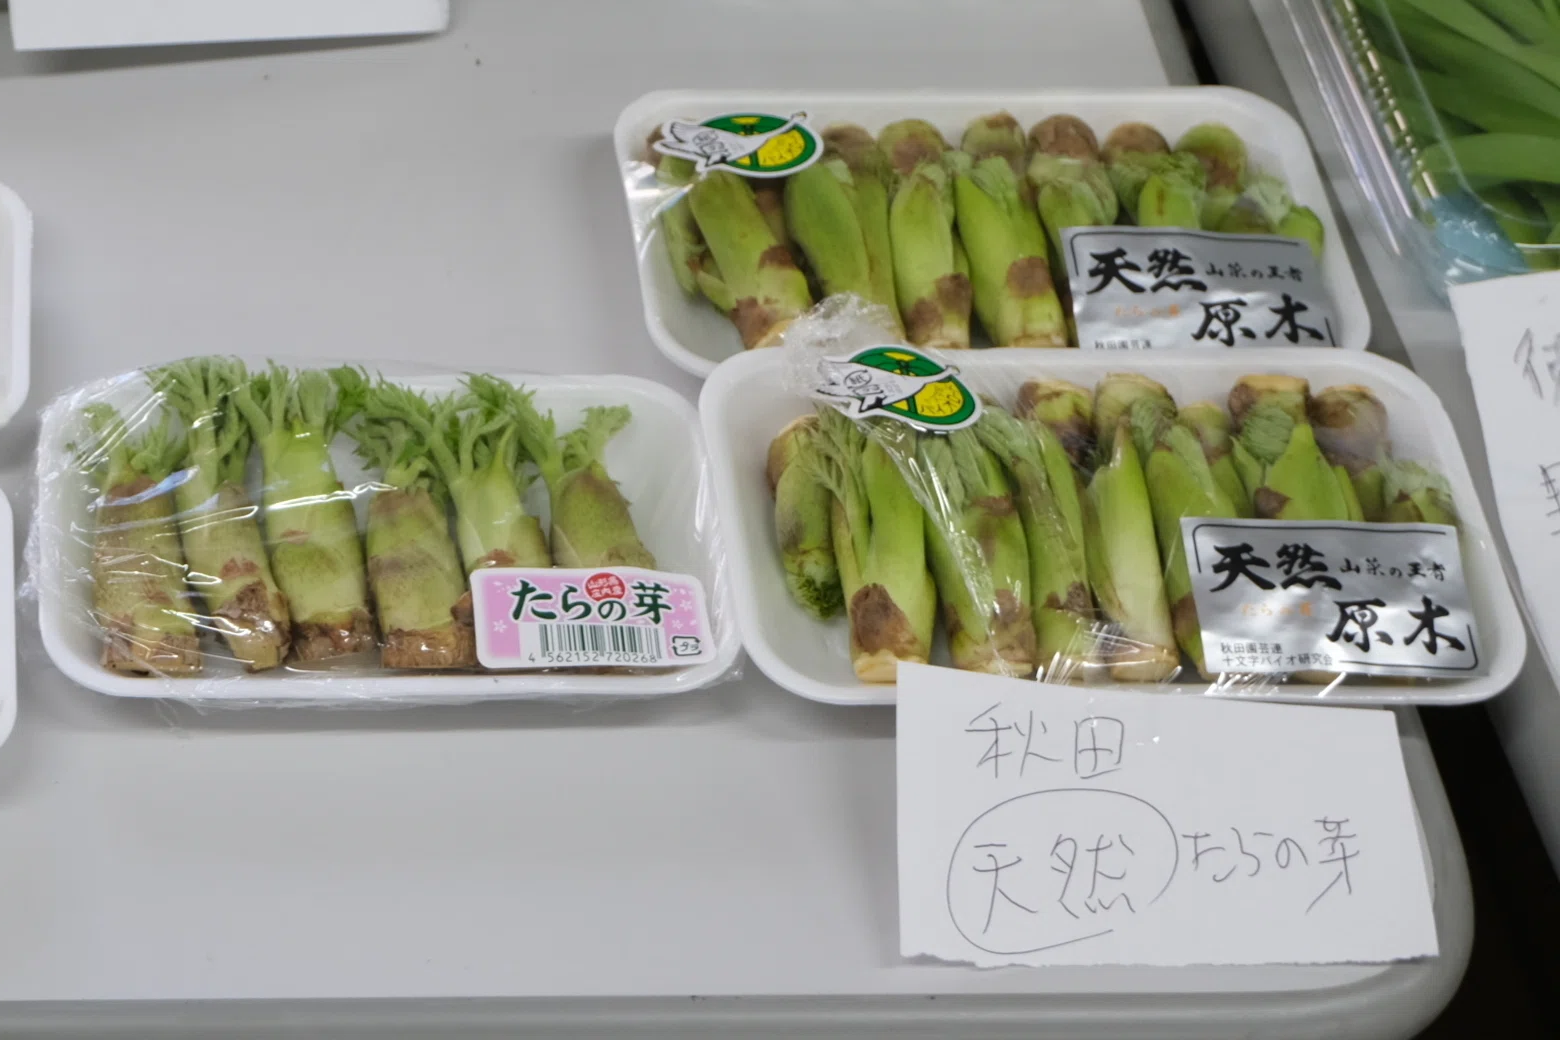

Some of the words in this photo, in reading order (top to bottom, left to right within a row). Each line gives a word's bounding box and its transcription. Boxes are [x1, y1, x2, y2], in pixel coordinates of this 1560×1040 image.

[1191, 293, 1325, 347] 原木
[1210, 542, 1342, 592] 天然
[1340, 558, 1447, 581] 山菜の王者
[510, 578, 673, 626] たらの芽
[1326, 595, 1466, 654] 原木
[528, 653, 536, 664] 4
[964, 702, 1125, 779] 秋田
